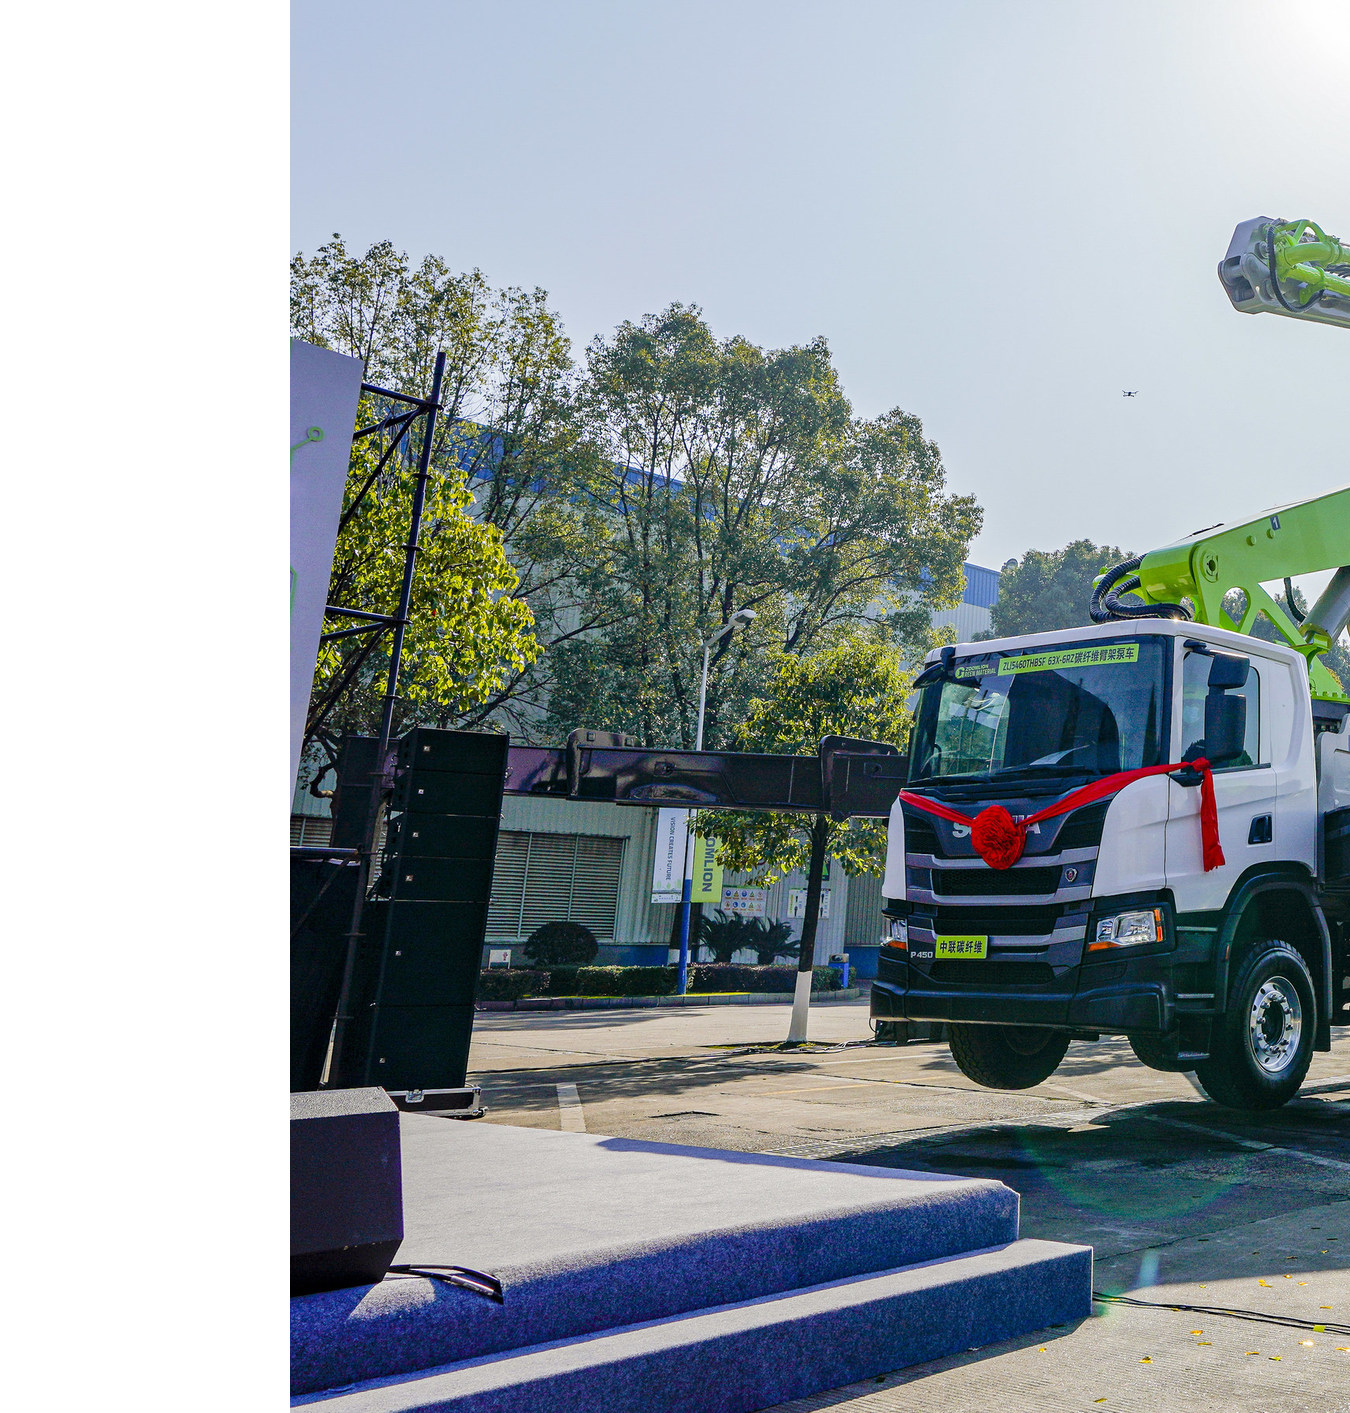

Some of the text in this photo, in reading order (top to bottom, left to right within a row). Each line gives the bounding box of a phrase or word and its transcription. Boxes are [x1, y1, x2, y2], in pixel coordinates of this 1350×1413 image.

[667, 835, 675, 860] CREATES
[665, 860, 673, 881] FUTURE
[701, 837, 716, 892] OMLION
[939, 940, 983, 954] 中联碳纤维
